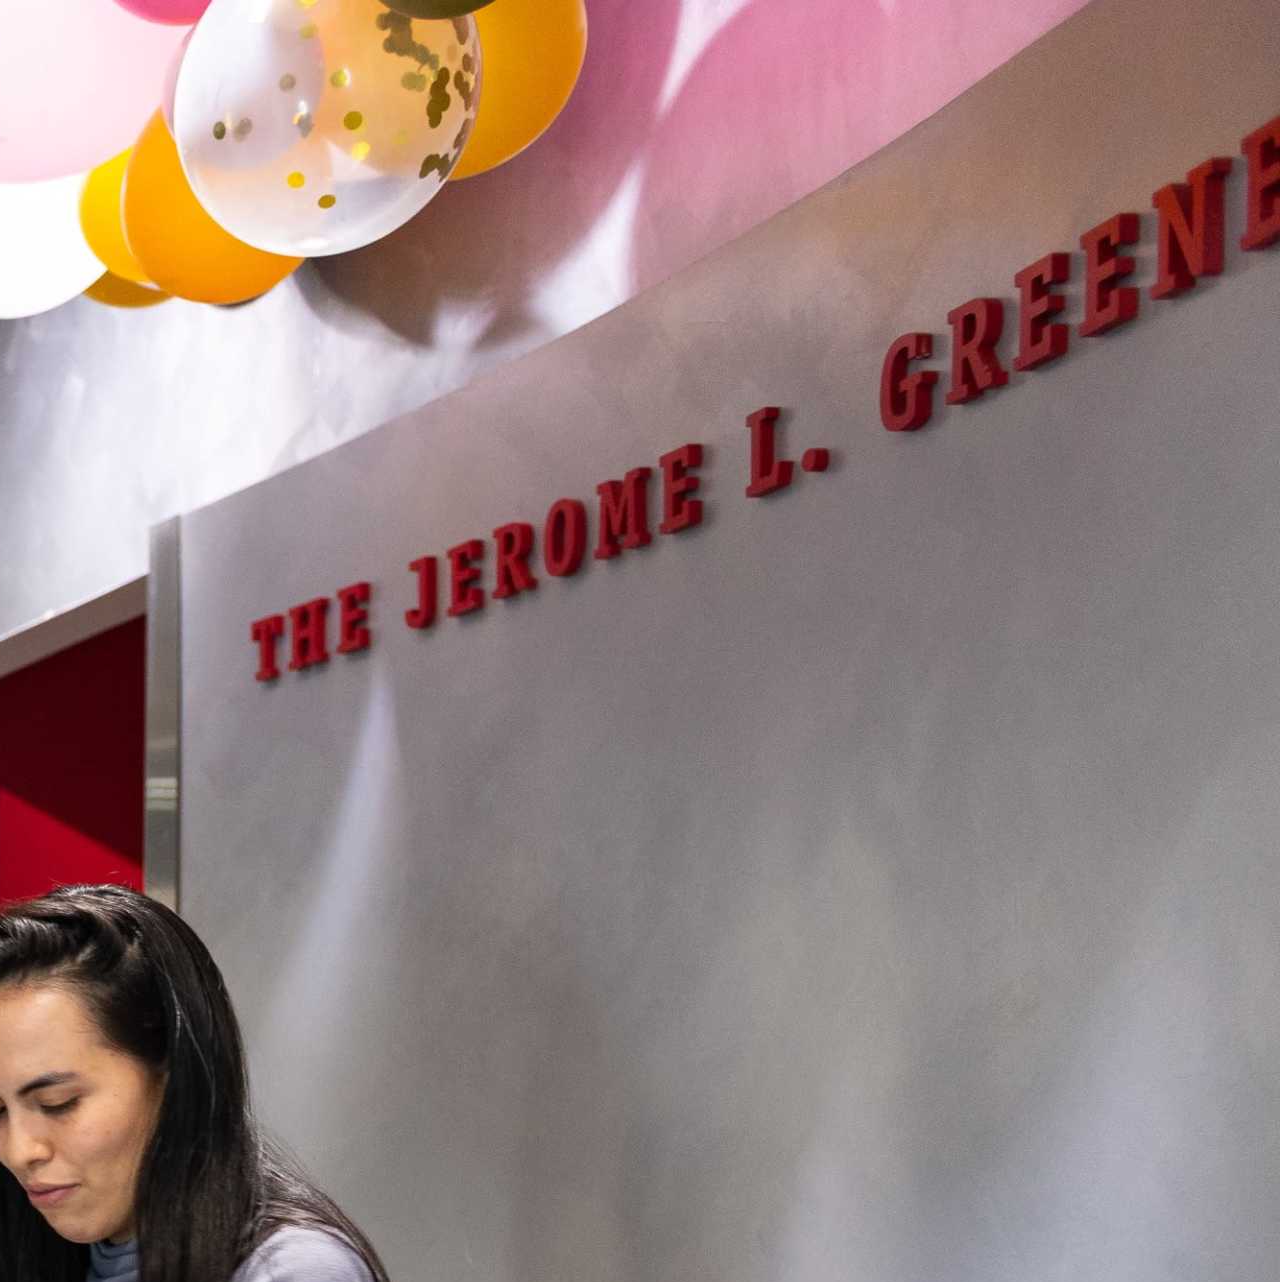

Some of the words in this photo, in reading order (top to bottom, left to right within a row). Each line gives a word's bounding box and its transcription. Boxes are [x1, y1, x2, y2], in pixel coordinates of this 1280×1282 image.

[251, 582, 372, 682] THE
[404, 443, 703, 629] JEROME
[745, 407, 829, 498] L.
[879, 115, 1280, 432] GREENE
